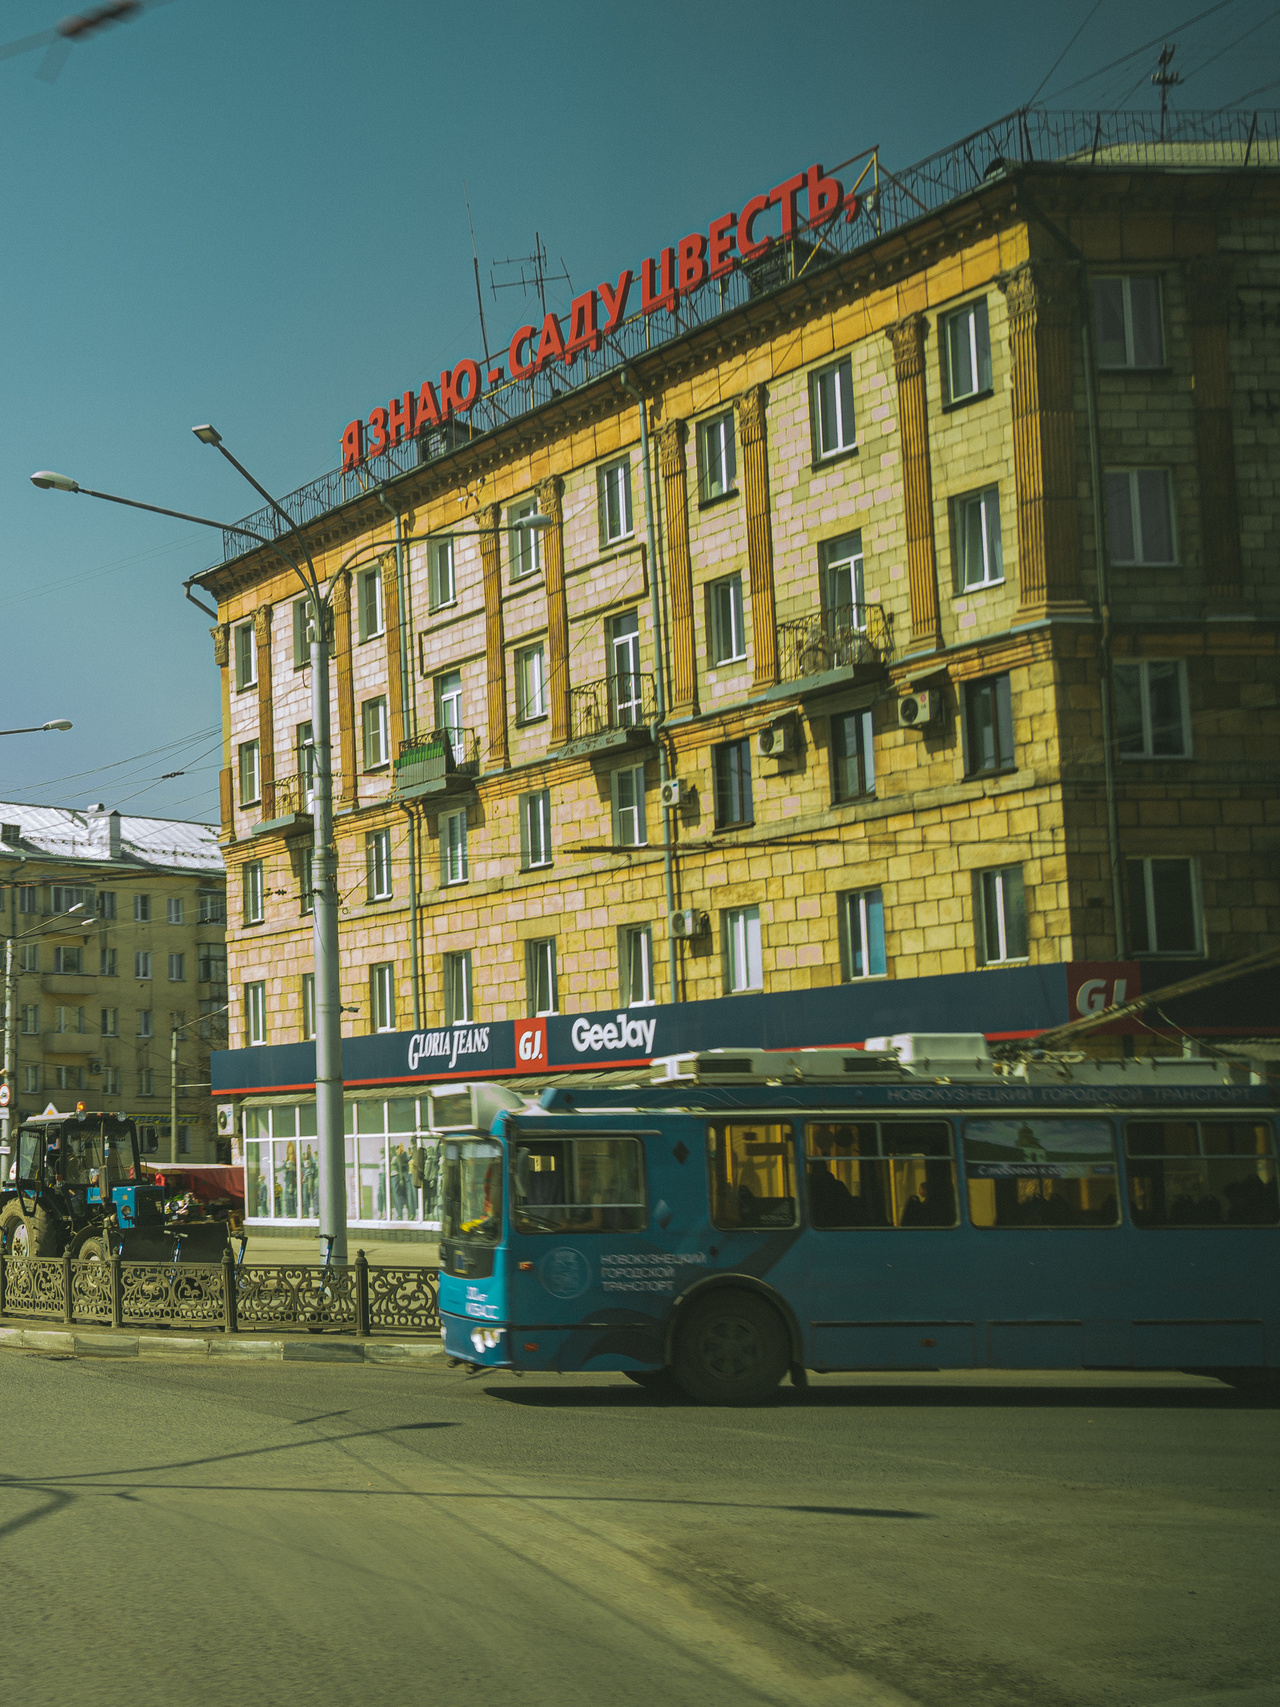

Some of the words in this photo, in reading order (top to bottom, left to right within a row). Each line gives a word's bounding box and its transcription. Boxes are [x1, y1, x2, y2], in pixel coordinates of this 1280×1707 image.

[342, 420, 363, 474] Я
[368, 359, 482, 458] ЗНАЮ
[508, 269, 634, 382] САДУ
[641, 163, 862, 317] ЦВЕСТЬ,
[571, 1014, 656, 1054] GeeJay
[408, 1033, 451, 1070] GLORIA
[449, 1027, 490, 1069] JEANS
[601, 1253, 707, 1265] НОВОКУЗНЕЦКИЙ
[601, 1266, 675, 1278] ГОРОДСКОЙ
[602, 1280, 675, 1292] ТРАНСПОРТ
